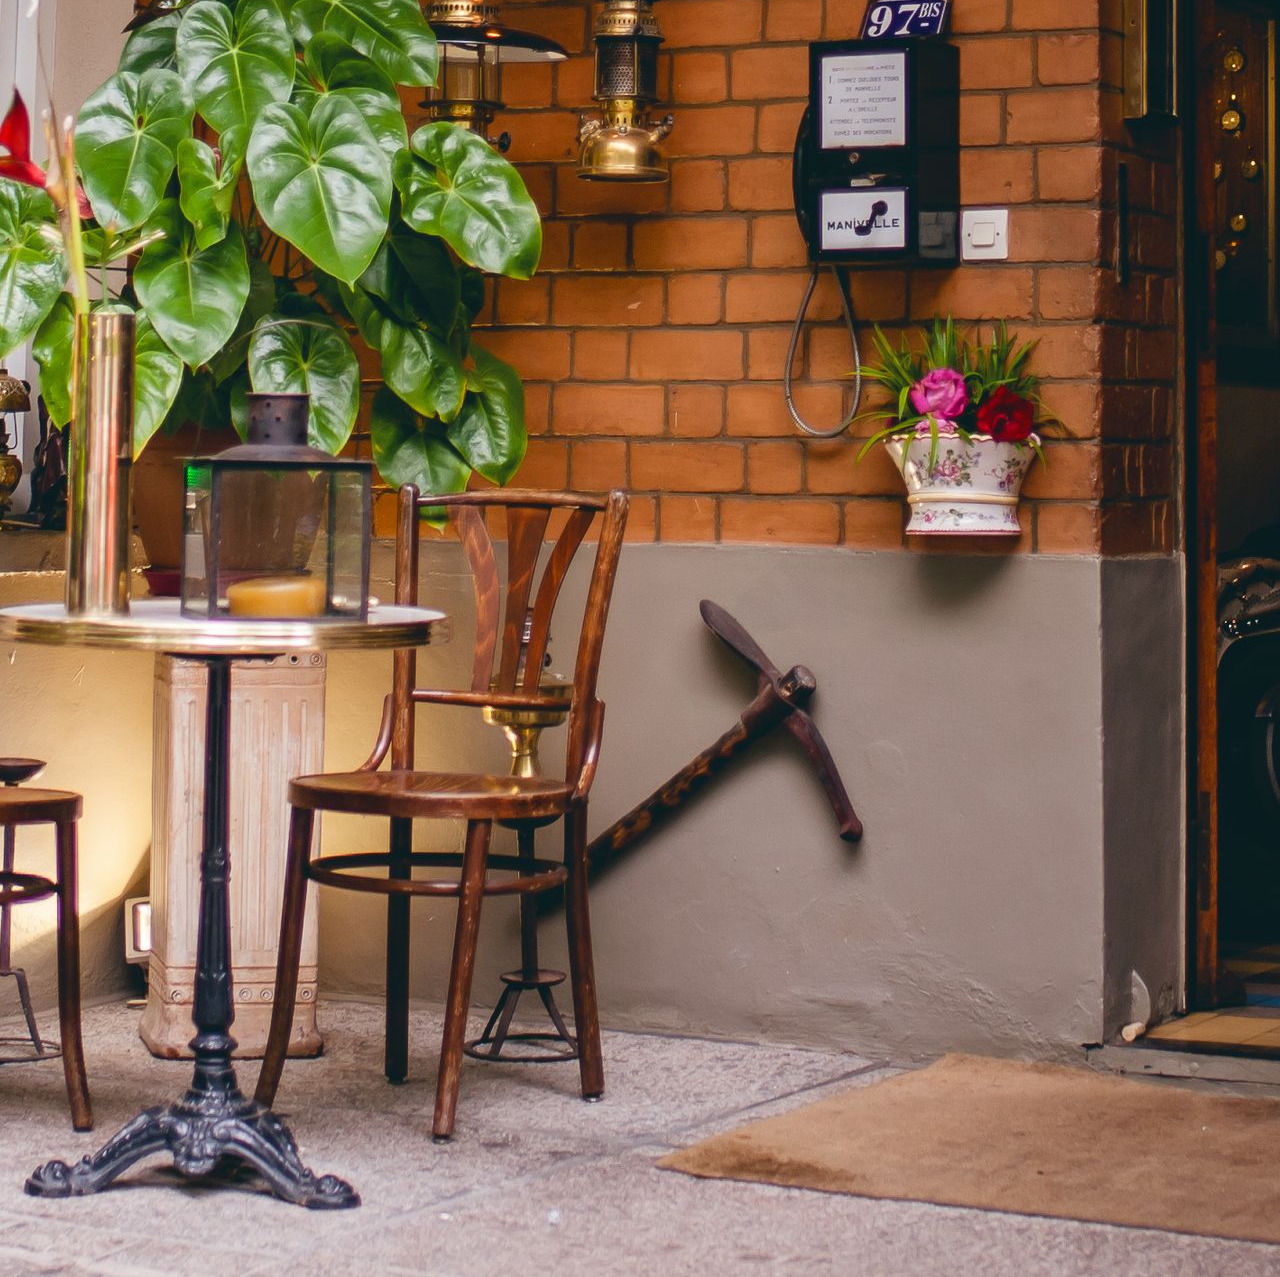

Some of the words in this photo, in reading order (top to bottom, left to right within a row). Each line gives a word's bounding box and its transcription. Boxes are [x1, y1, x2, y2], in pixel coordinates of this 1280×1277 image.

[867, 3, 921, 38] 97
[919, 1, 942, 19] BIS
[828, 95, 833, 105] 2
